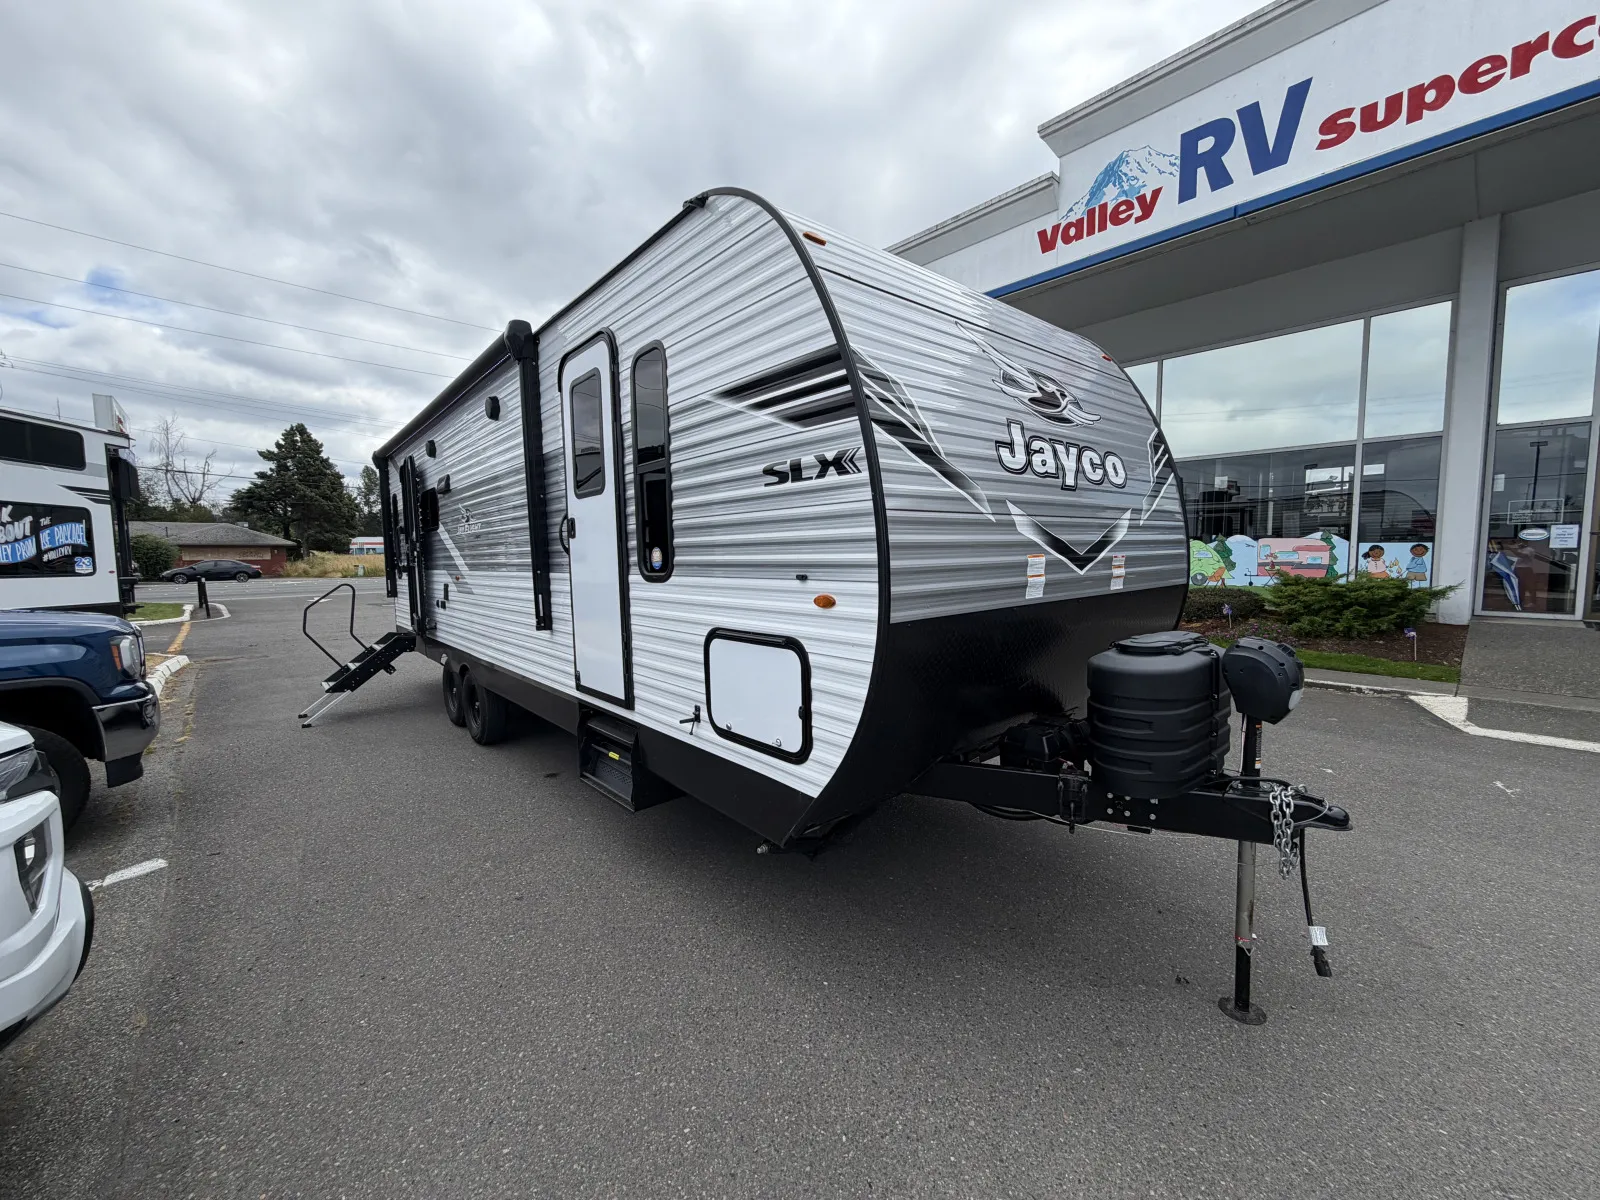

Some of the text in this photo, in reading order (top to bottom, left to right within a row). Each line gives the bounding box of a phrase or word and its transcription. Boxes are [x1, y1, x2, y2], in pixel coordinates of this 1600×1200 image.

[1037, 15, 1600, 254] valley RV superc
[762, 447, 862, 487] SLX
[995, 419, 1127, 491] Jayco
[0, 505, 13, 523] K
